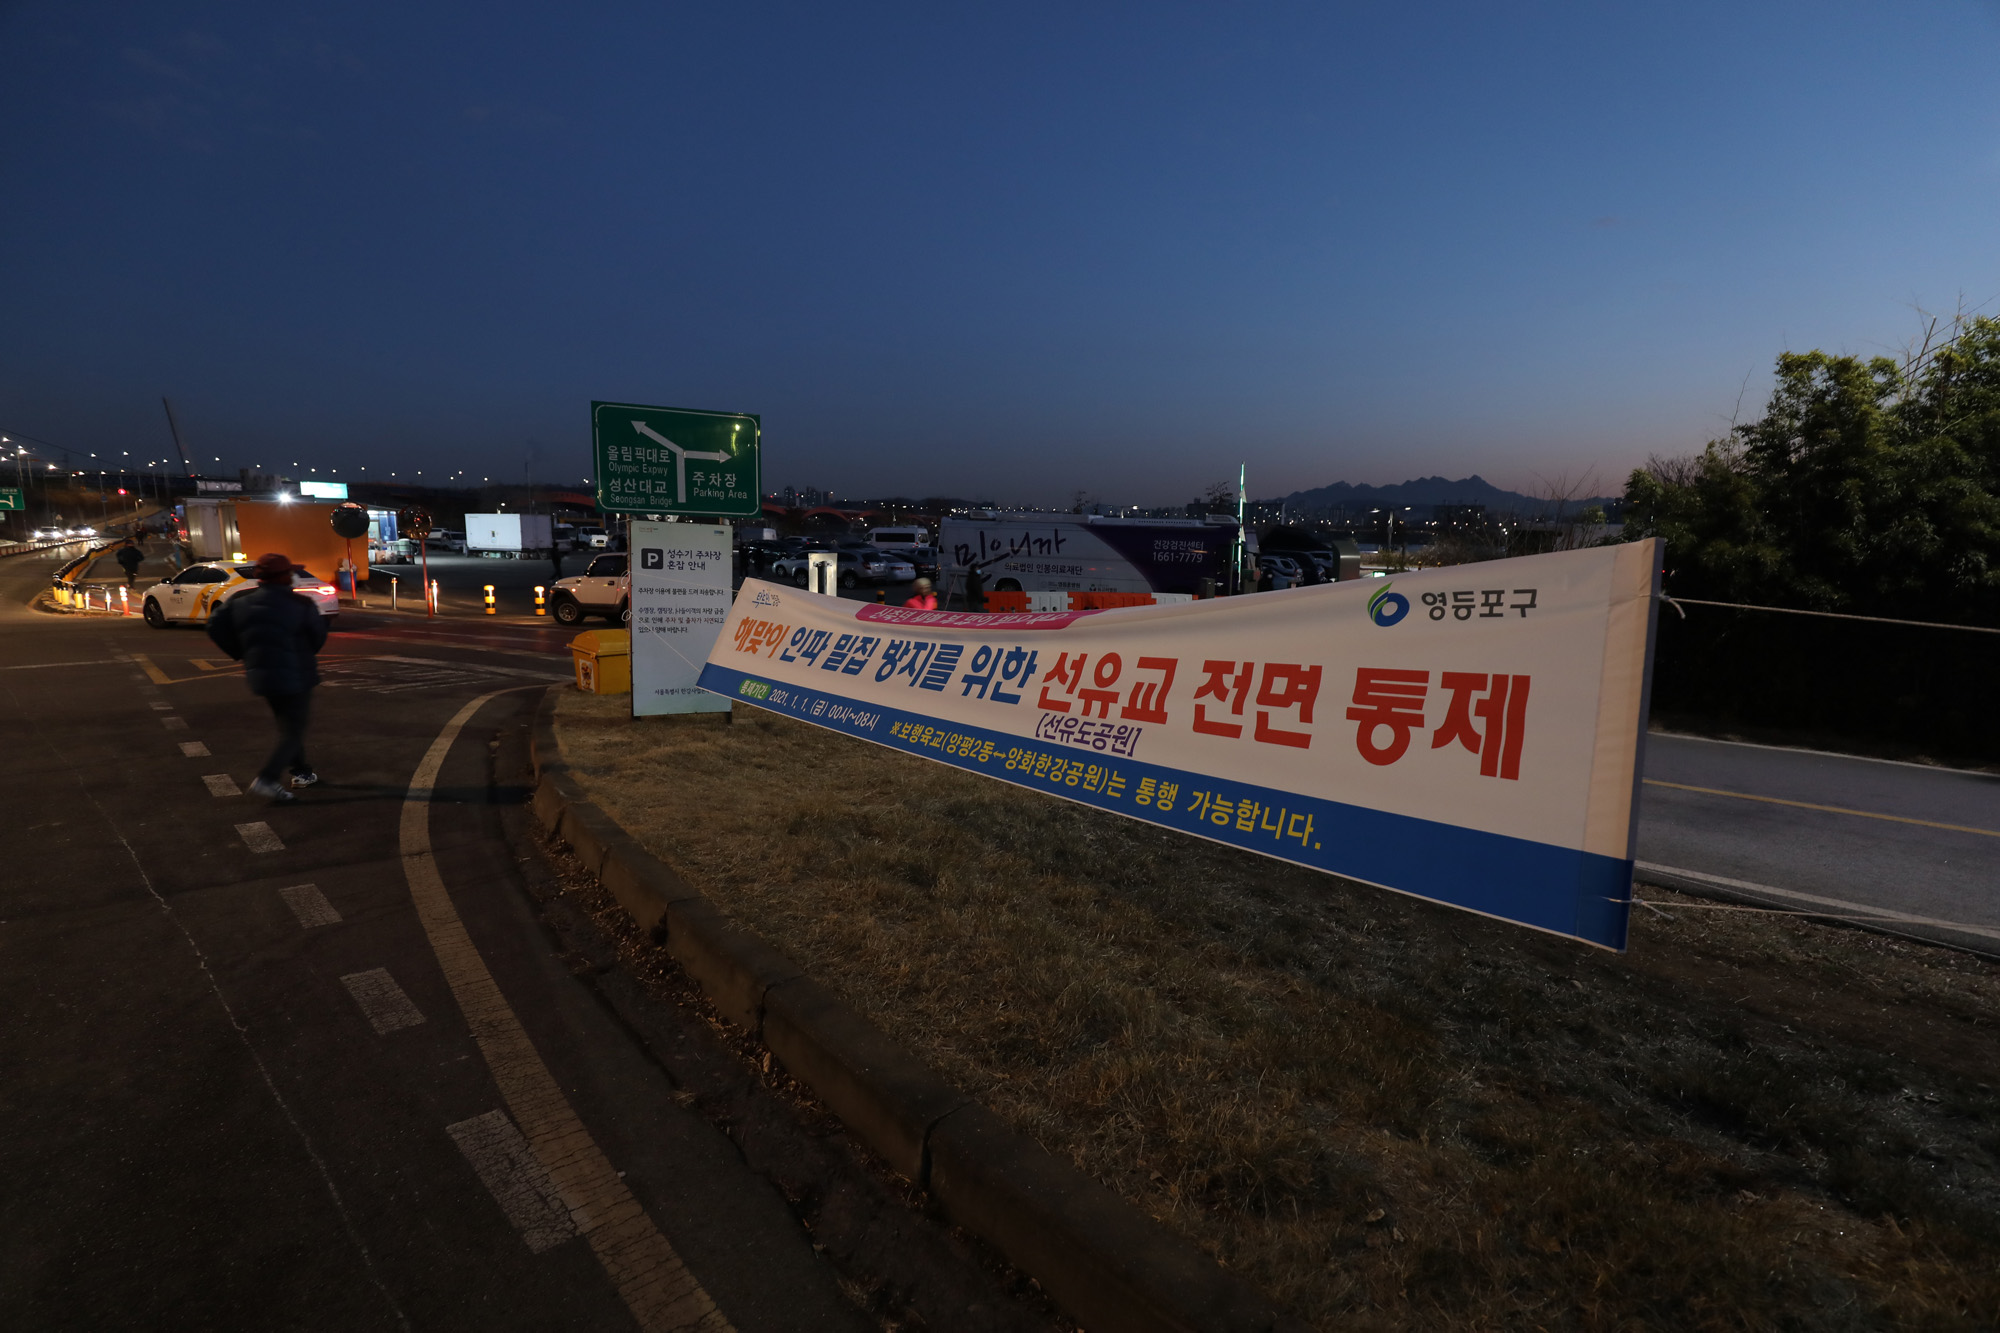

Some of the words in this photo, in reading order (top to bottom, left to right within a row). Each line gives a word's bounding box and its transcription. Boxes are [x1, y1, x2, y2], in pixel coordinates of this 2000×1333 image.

[607, 445, 670, 463] 올림픽대로
[608, 462, 640, 474] Olympic
[642, 463, 668, 476] Expwy
[609, 477, 667, 494] 성산대교
[692, 471, 737, 488] 주차장
[610, 493, 645, 507] Seongsan
[650, 495, 673, 508] Bridge
[693, 487, 725, 499] Parking
[728, 489, 748, 499] Area
[1153, 539, 1204, 551] 건강검진센터
[667, 549, 693, 559] 성수기
[695, 550, 722, 561] 주차장
[1152, 551, 1203, 563] 1661-7779
[667, 560, 685, 571] 혼잡
[688, 561, 706, 571] 안내
[1004, 561, 1034, 573] 의료법인
[1036, 562, 1084, 576] 인봉의료재단
[1420, 588, 1538, 621] 영등포구
[734, 616, 791, 659] 해맞이
[779, 626, 834, 667] 인파
[821, 633, 881, 676] 밀집
[874, 639, 964, 692] 방지를
[961, 644, 1039, 705] 위한
[1037, 650, 1179, 725] 선유교
[1192, 659, 1323, 749] 전면
[1345, 667, 1531, 781] 통제
[740, 680, 769, 699] 통제기간
[809, 698, 830, 717] (금)
[1135, 777, 1179, 811] 통행
[1187, 790, 1322, 850] 가능합니다.
